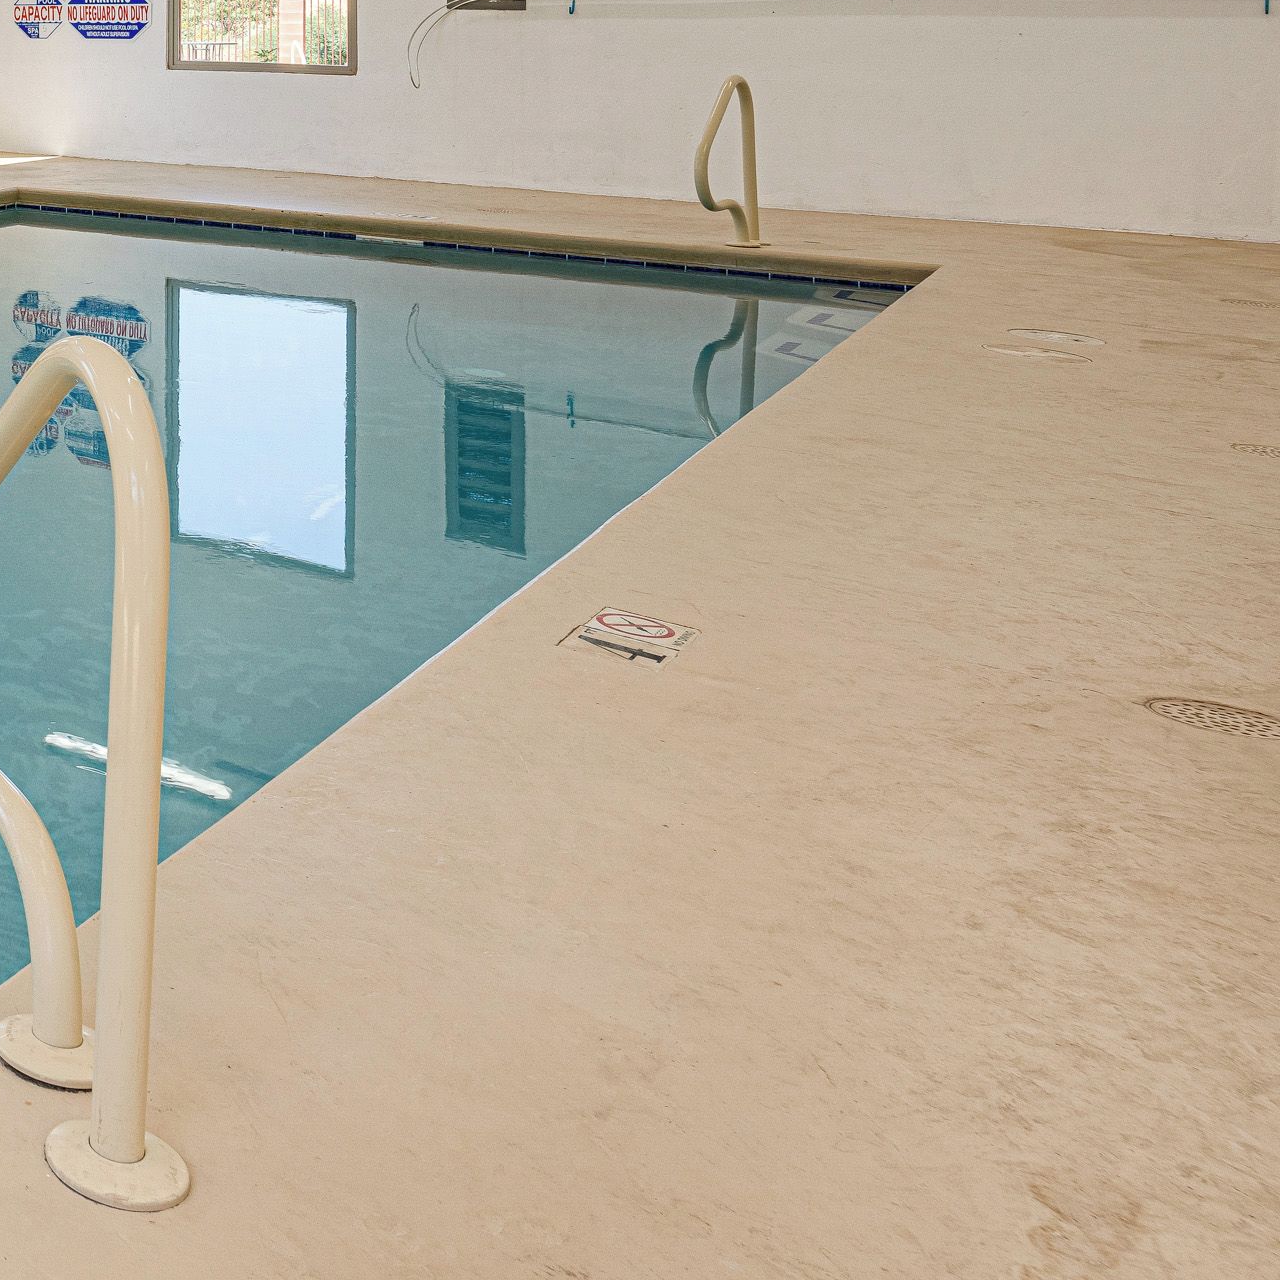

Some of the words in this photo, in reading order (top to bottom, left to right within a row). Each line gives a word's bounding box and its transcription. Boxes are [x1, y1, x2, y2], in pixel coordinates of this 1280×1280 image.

[14, 6, 62, 20] CAPACITY
[68, 6, 77, 20] NO
[80, 6, 116, 20] LIFEGUARD
[118, 6, 128, 20] ON
[131, 6, 148, 20] DUTY
[578, 634, 667, 663] 4
